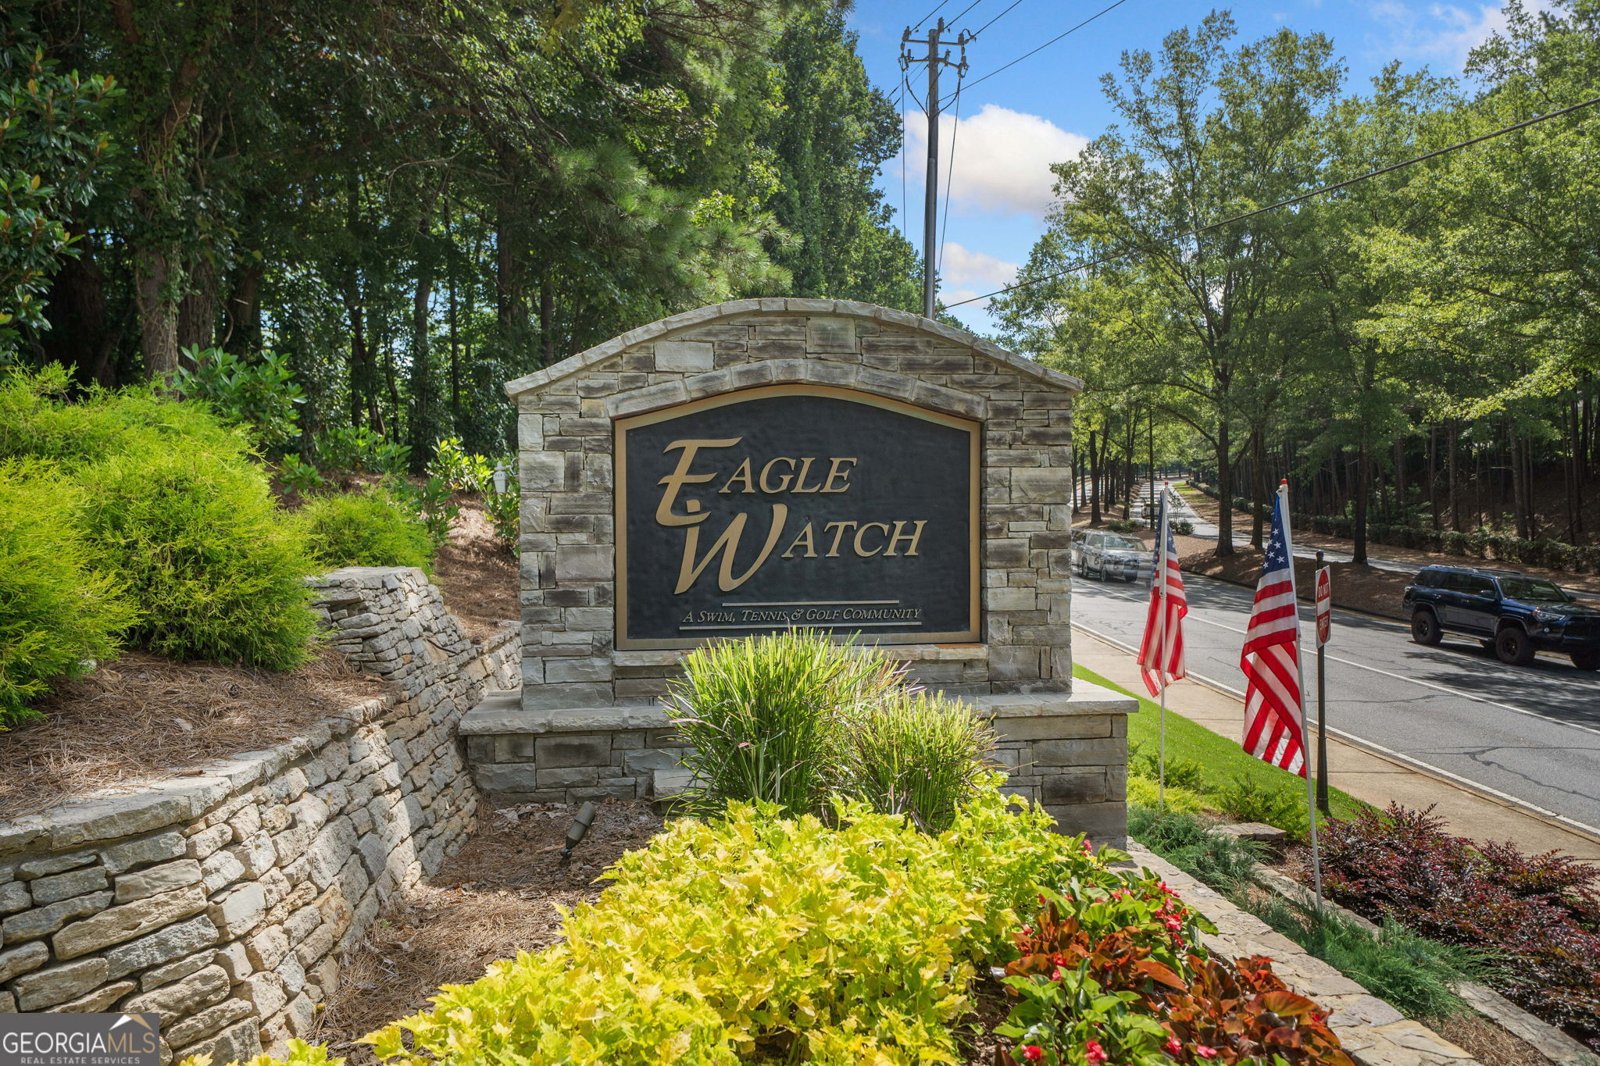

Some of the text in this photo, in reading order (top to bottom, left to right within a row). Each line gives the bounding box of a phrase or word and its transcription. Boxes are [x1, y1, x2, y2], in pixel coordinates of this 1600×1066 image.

[655, 436, 858, 527] EAGLE
[674, 503, 928, 595] WATCH
[683, 611, 694, 623] A
[791, 609, 804, 620] &
[806, 608, 840, 620] GOLF
[843, 607, 922, 620] COMMUNITY
